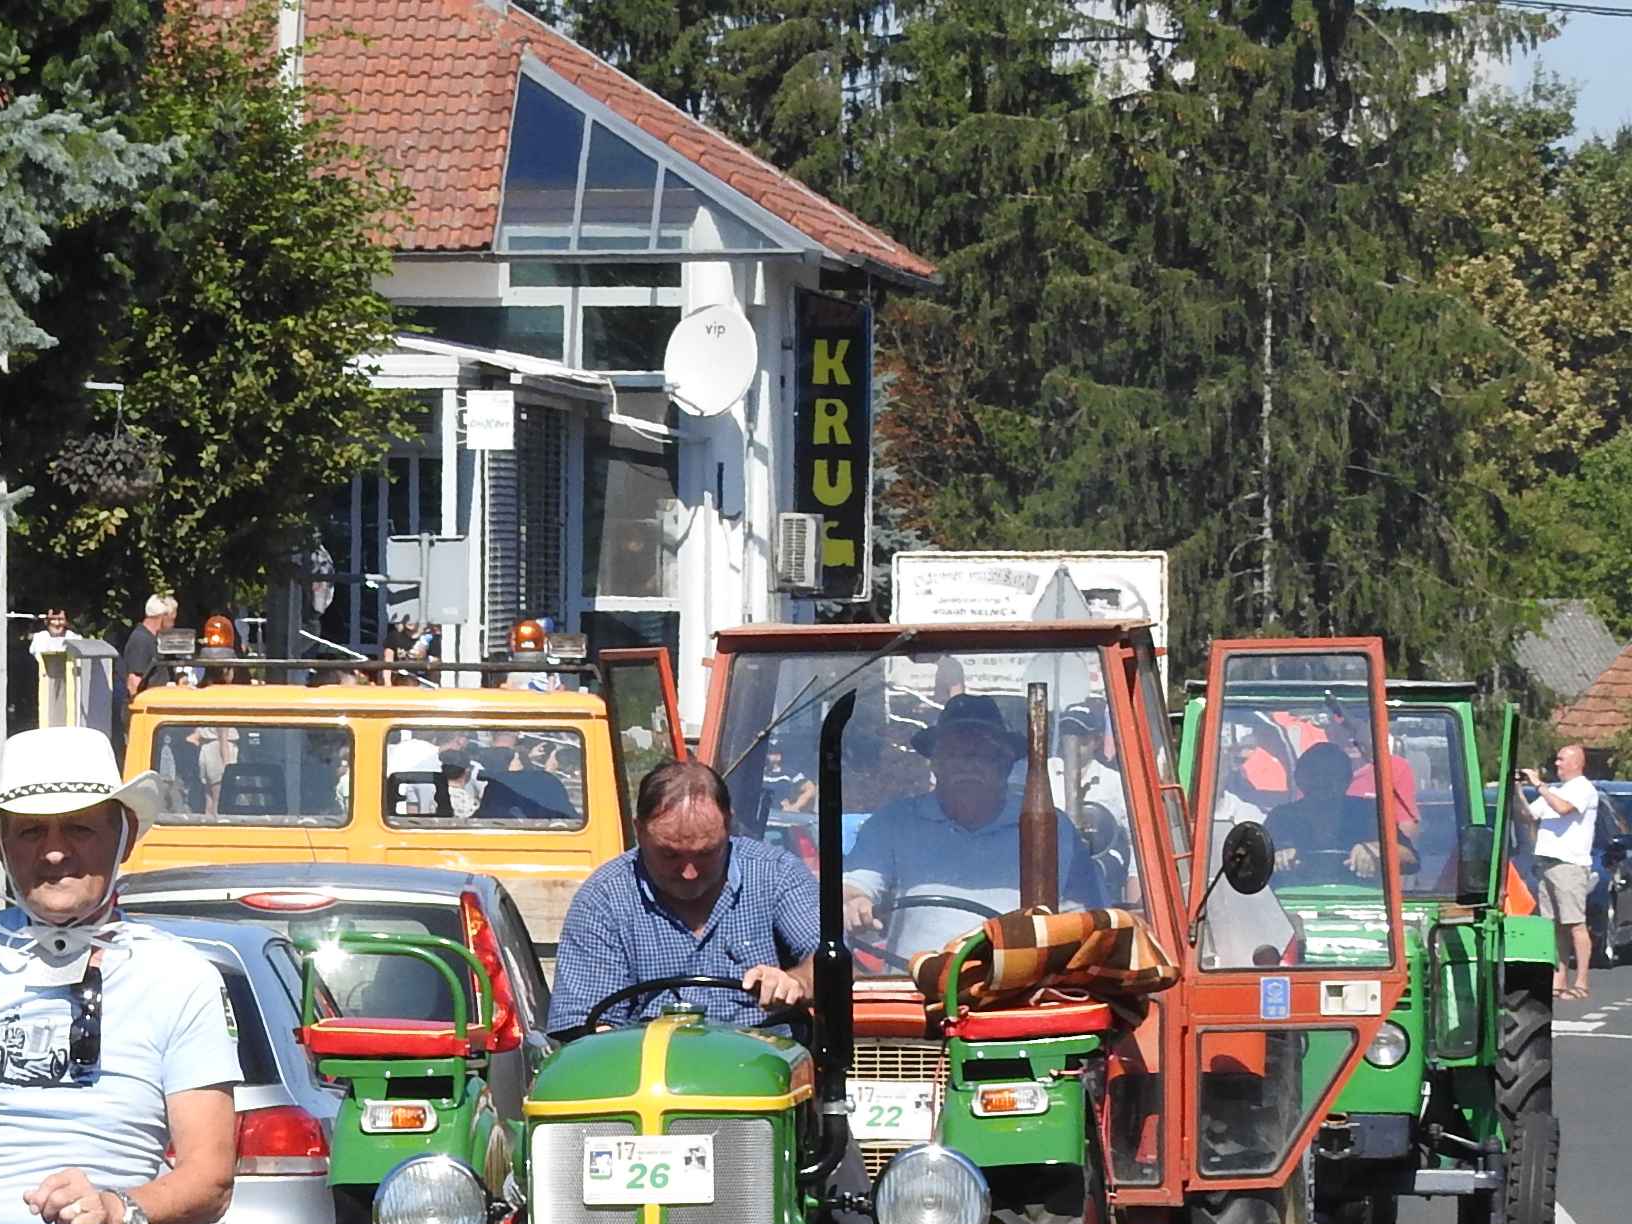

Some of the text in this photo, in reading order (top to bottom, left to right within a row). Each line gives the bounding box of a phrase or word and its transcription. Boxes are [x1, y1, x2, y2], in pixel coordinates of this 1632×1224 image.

[705, 320, 726, 339] vip
[866, 1105, 903, 1128] 22
[626, 1162, 671, 1189] 26
